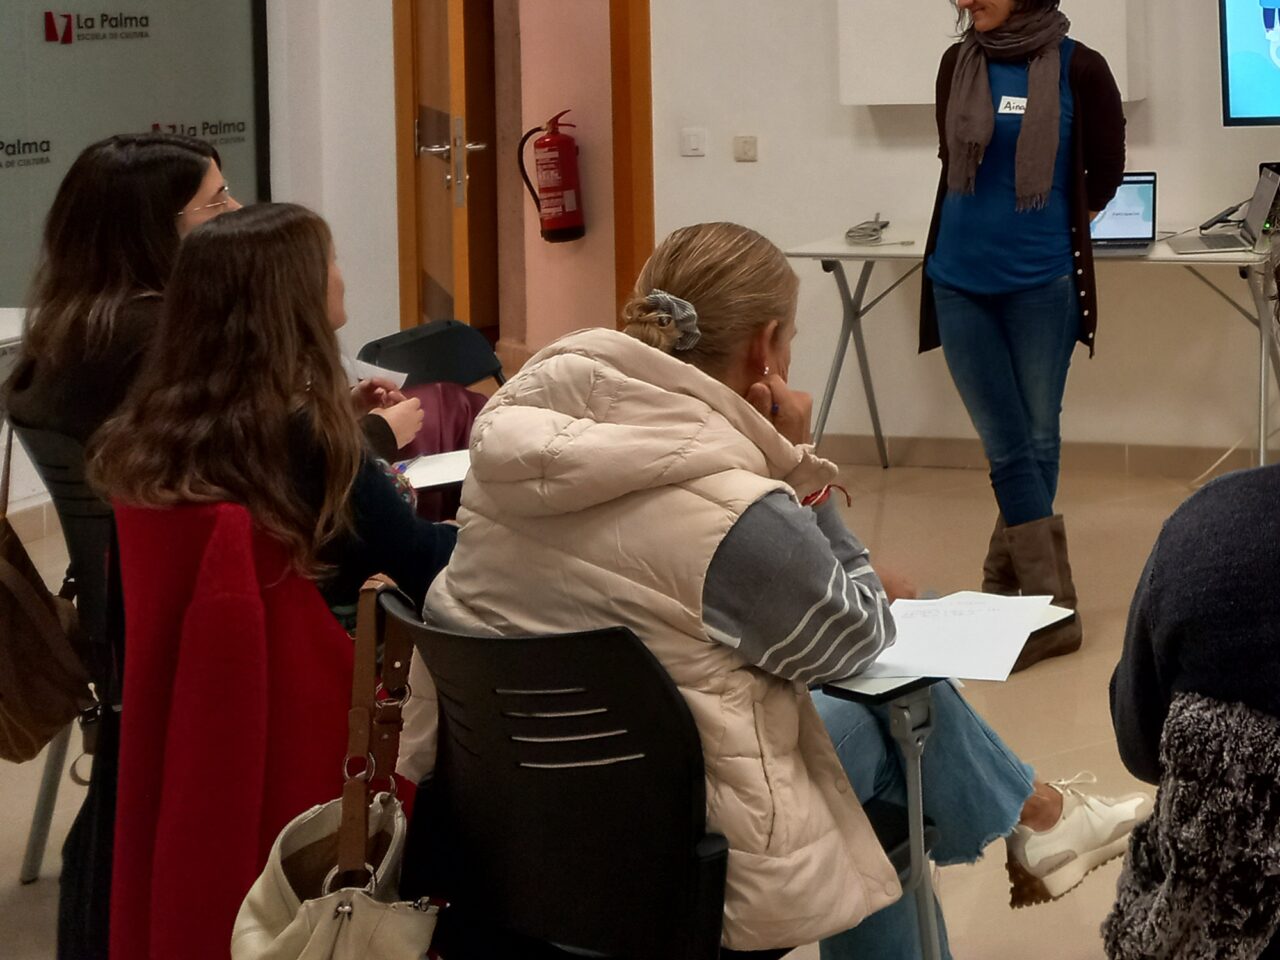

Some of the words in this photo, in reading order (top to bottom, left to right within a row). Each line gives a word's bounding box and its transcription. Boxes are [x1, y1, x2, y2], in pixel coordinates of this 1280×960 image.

[76, 14, 95, 29] La
[100, 12, 149, 28] Palma
[202, 121, 245, 136] Palma
